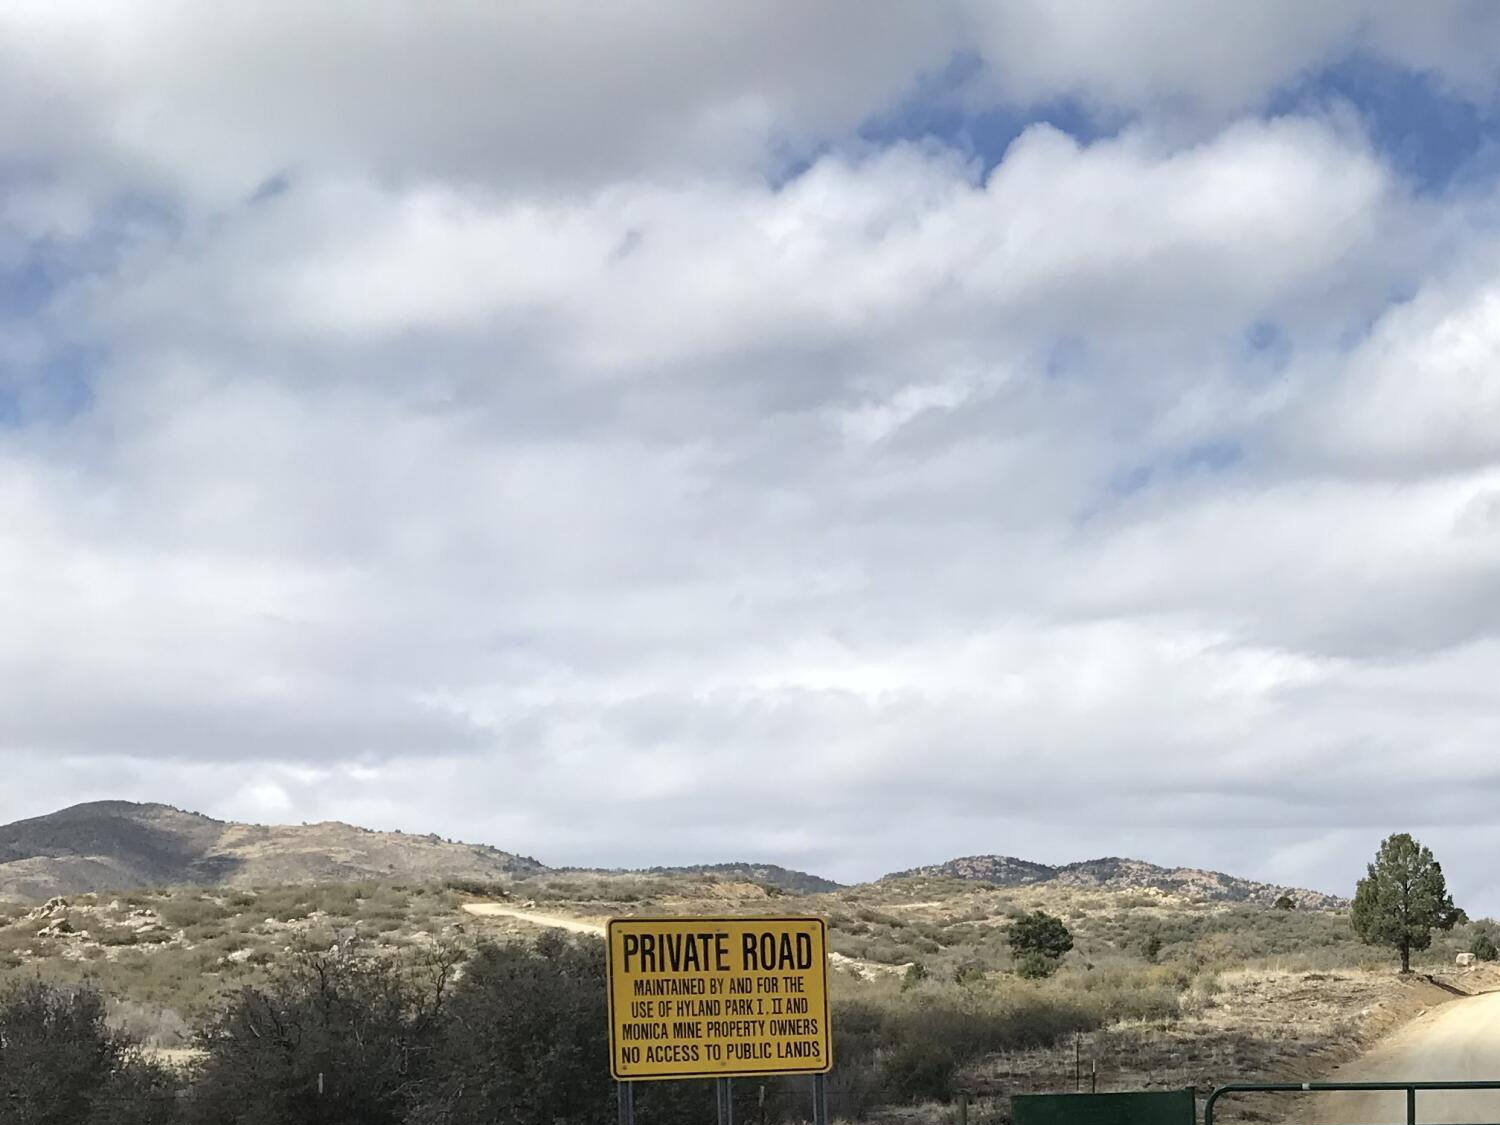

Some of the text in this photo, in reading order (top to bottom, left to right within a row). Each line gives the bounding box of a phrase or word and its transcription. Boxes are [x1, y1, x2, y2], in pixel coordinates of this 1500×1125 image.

[623, 932, 811, 973] PRIVATE ROAD
[634, 977, 804, 996] MAINTAINED BY AND FOR THE
[632, 1002, 653, 1018] USE
[659, 1001, 672, 1017] OF
[677, 1000, 720, 1017] HYLAND
[725, 999, 753, 1015] PARK
[772, 998, 783, 1014] II
[786, 998, 808, 1014] AND
[623, 1019, 818, 1040] MONICA MINE PROPERTY OWNERS
[622, 1042, 820, 1063] NO ACCESS TO PUBLIC LANDS
